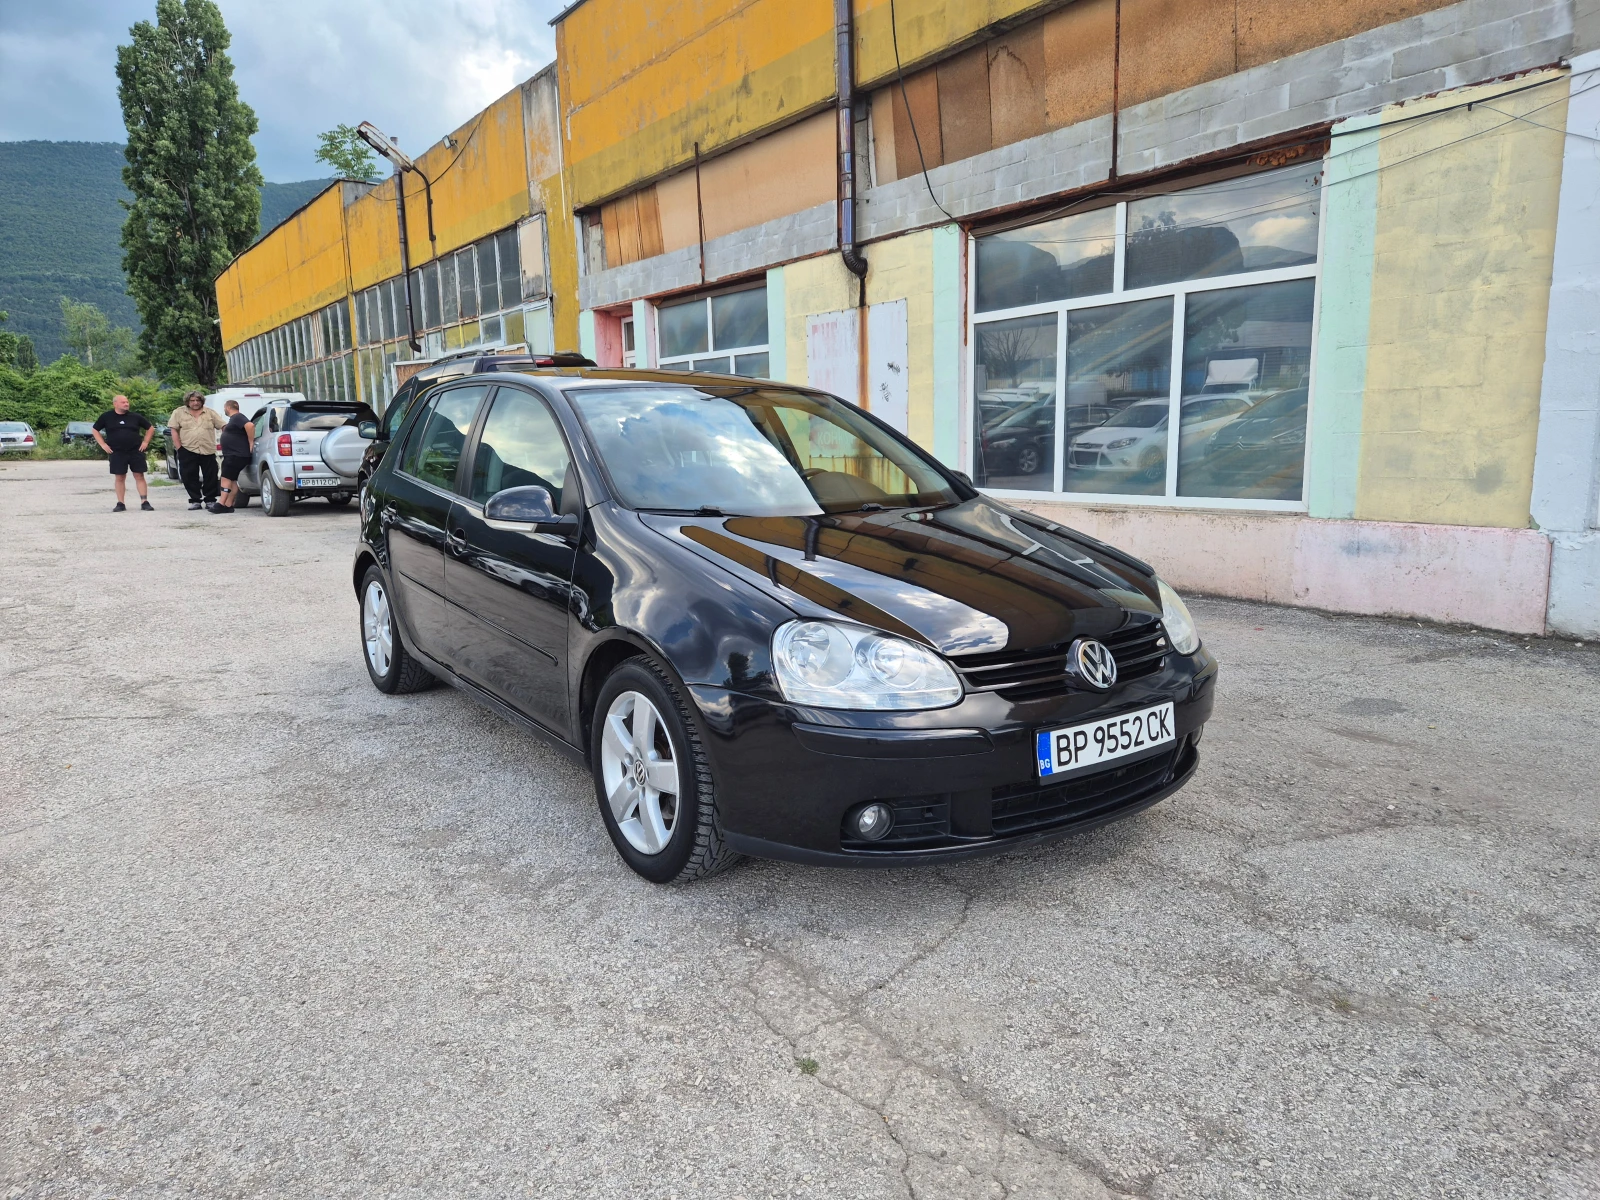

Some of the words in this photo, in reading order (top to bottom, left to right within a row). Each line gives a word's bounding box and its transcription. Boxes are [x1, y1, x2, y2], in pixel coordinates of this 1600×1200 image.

[1056, 730, 1088, 767] BP
[1093, 715, 1145, 758] 9552
[1146, 707, 1172, 742] CK
[1039, 758, 1051, 770] BG
